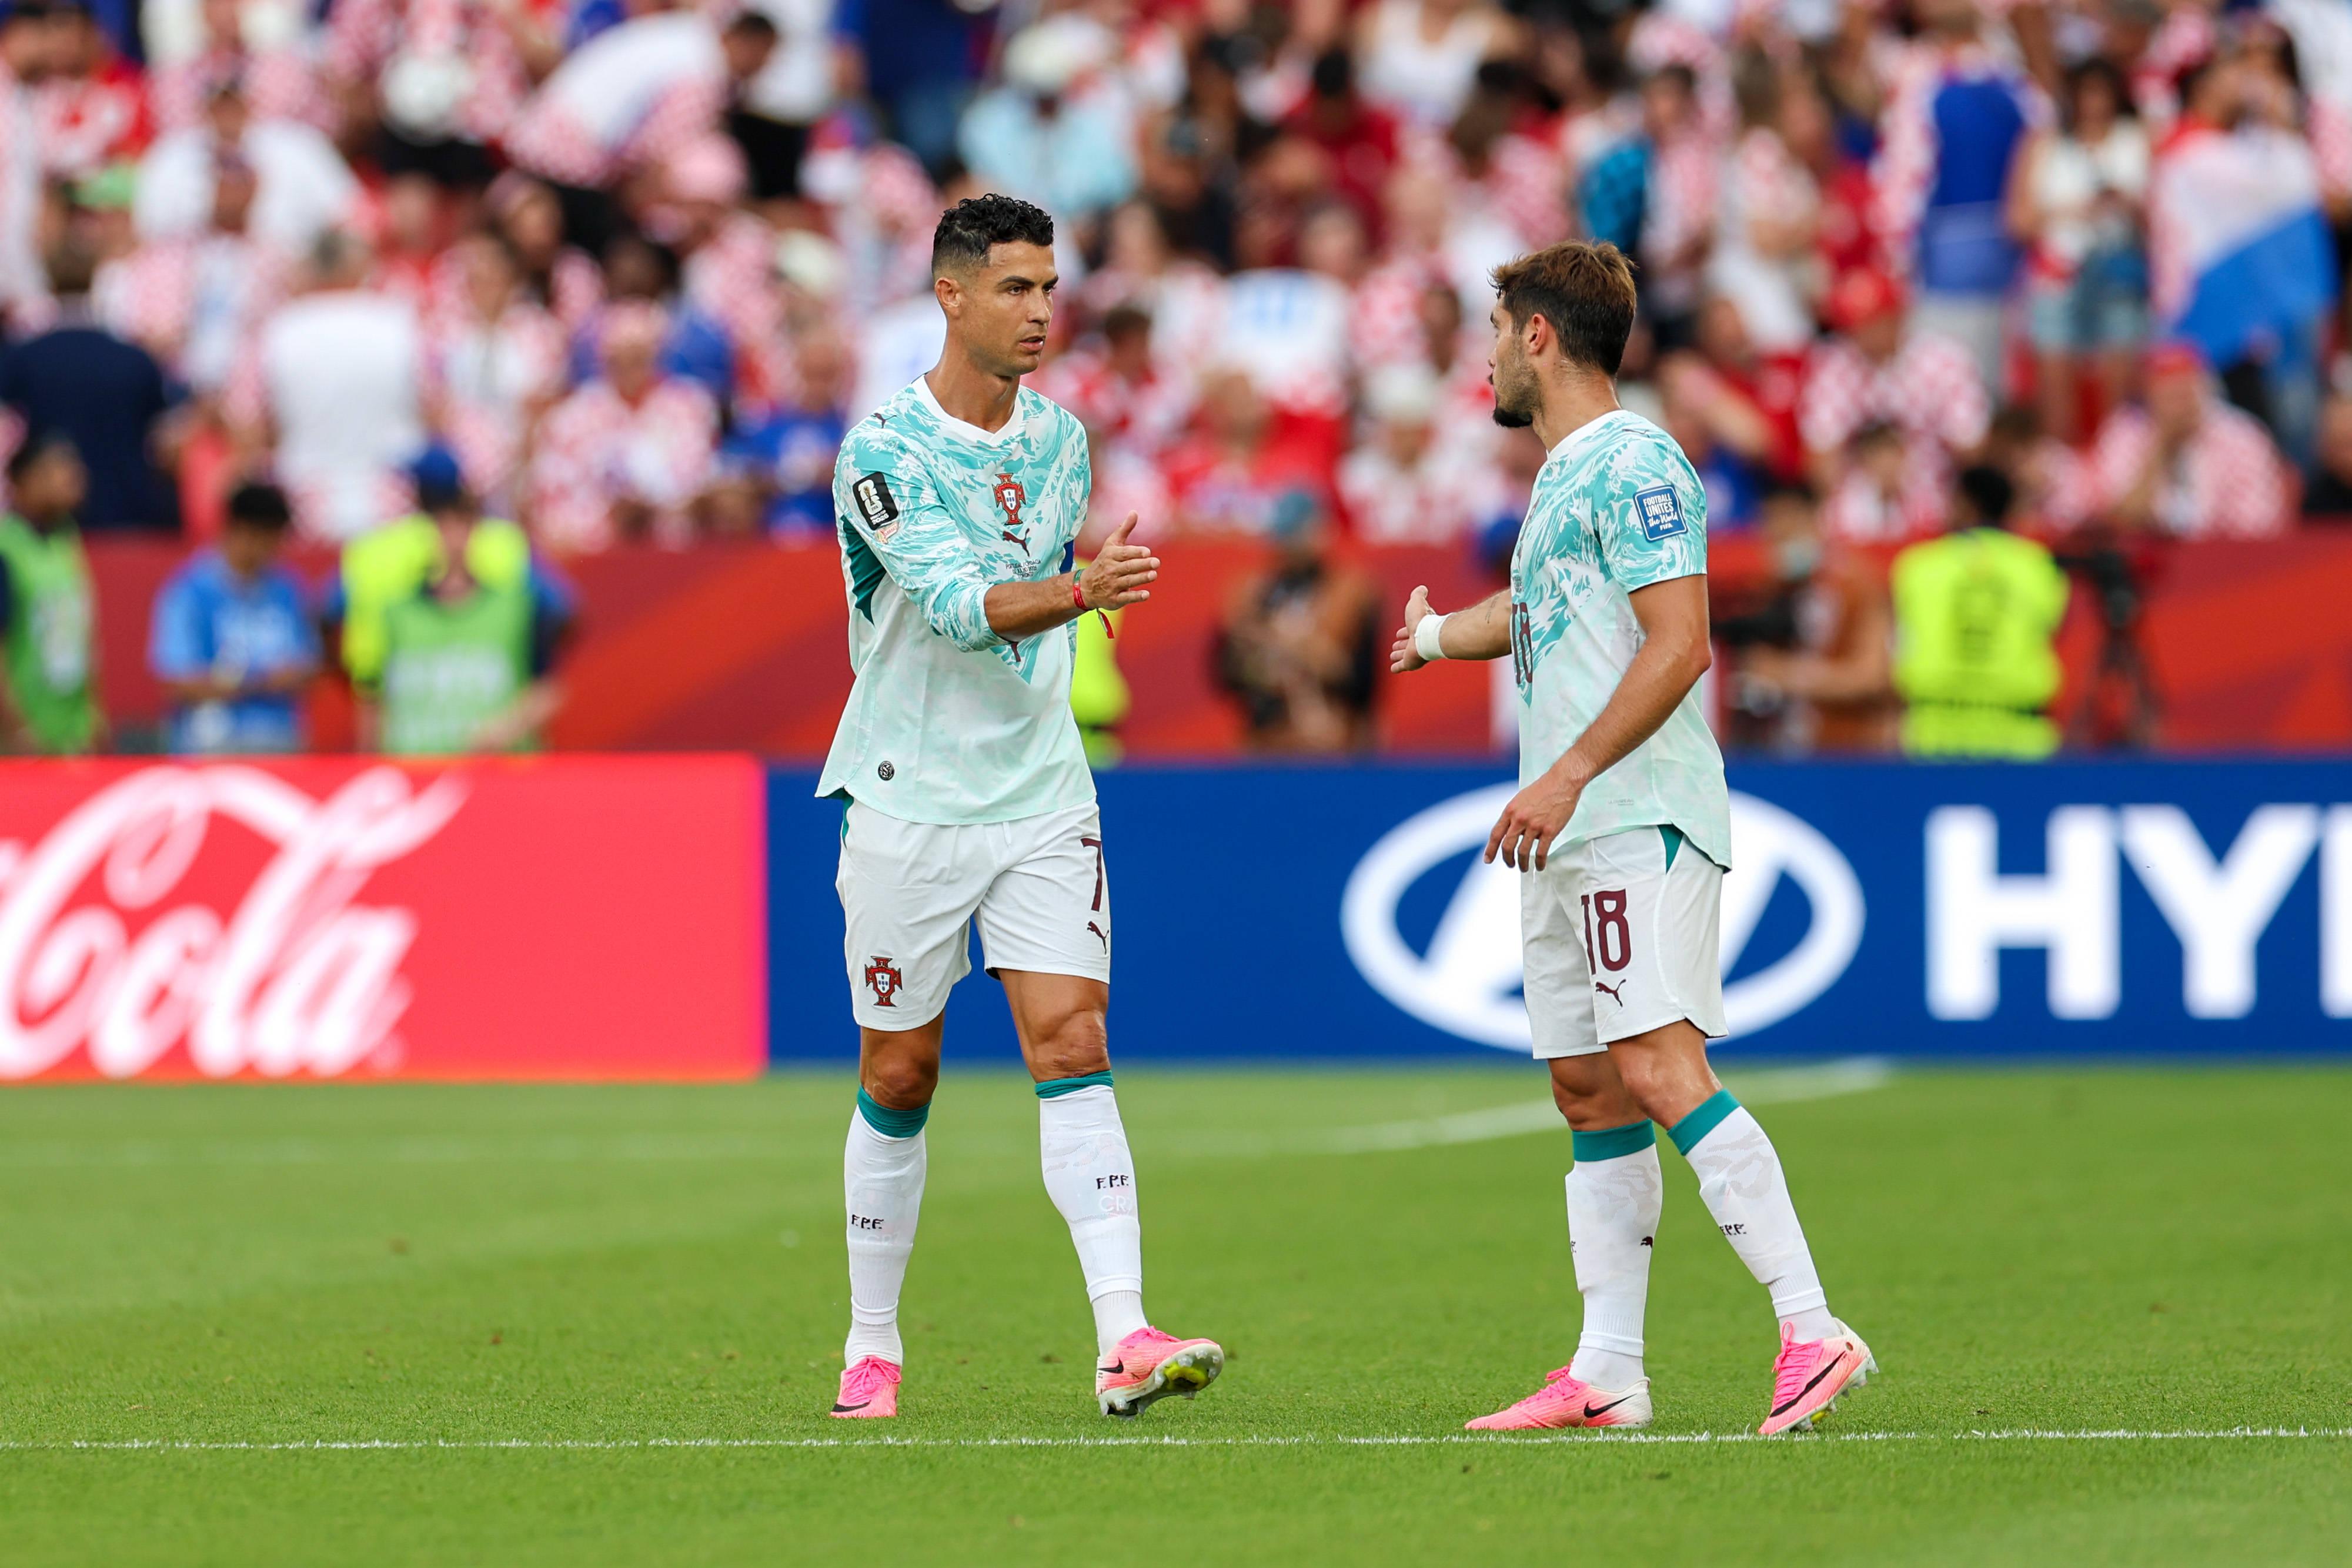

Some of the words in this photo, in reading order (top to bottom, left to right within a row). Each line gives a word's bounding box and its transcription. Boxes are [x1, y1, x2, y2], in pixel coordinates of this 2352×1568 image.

[1643, 493, 1672, 506] FOOTBALL
[1646, 502, 1673, 517] UNITES
[871, 513, 889, 525] 2026
[1648, 516, 1661, 527] the
[1659, 511, 1679, 524] World
[1659, 523, 1673, 531] FIFA
[1512, 602, 1533, 685] 18
[1080, 838, 1103, 912] 7
[1581, 888, 1632, 975] 18
